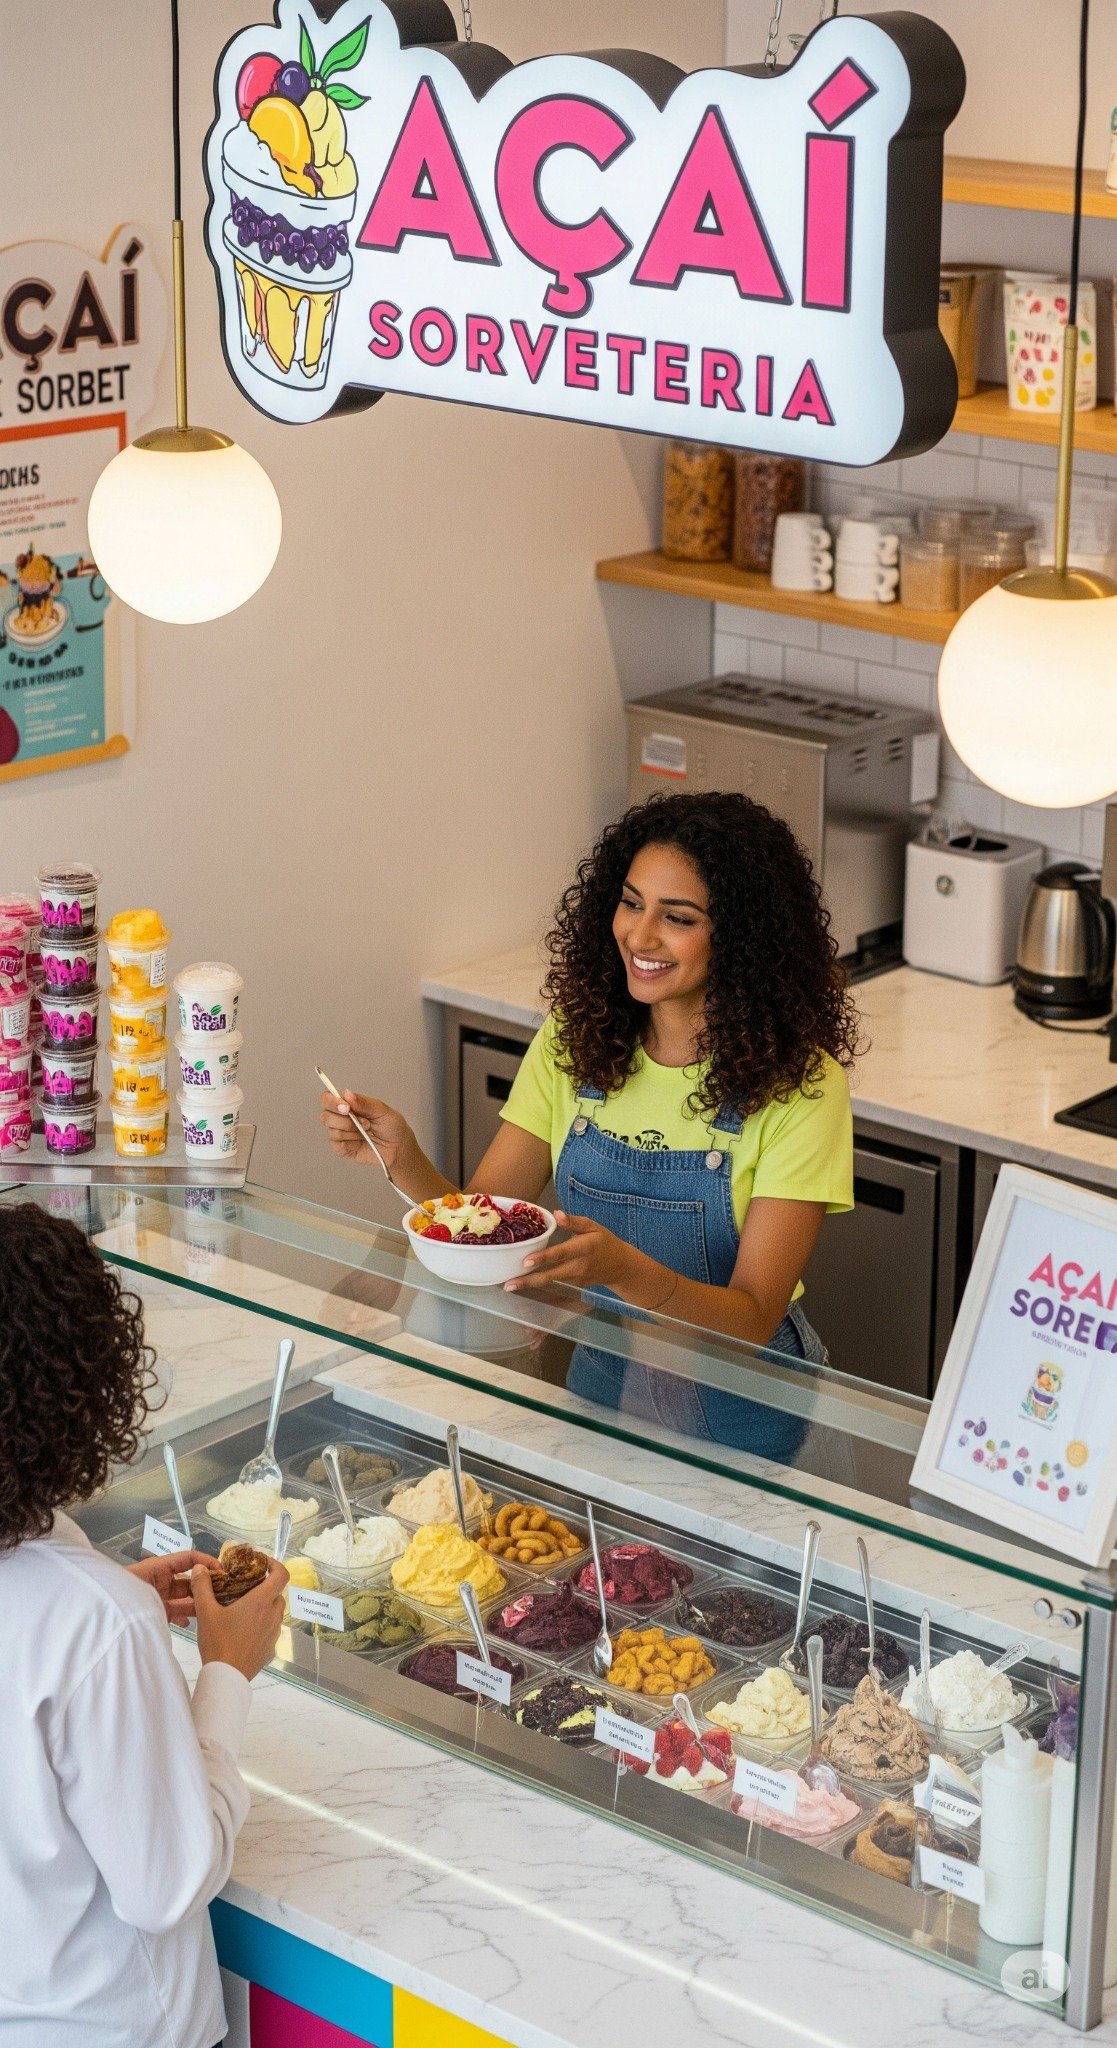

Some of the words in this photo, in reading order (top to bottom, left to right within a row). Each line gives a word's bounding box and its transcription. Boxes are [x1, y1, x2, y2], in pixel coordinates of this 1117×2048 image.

[356, 57, 878, 319] AÇAÍ
[0, 236, 144, 374] ÇAÍ
[368, 300, 837, 427] SORVETERIA
[17, 364, 131, 414] SORBET
